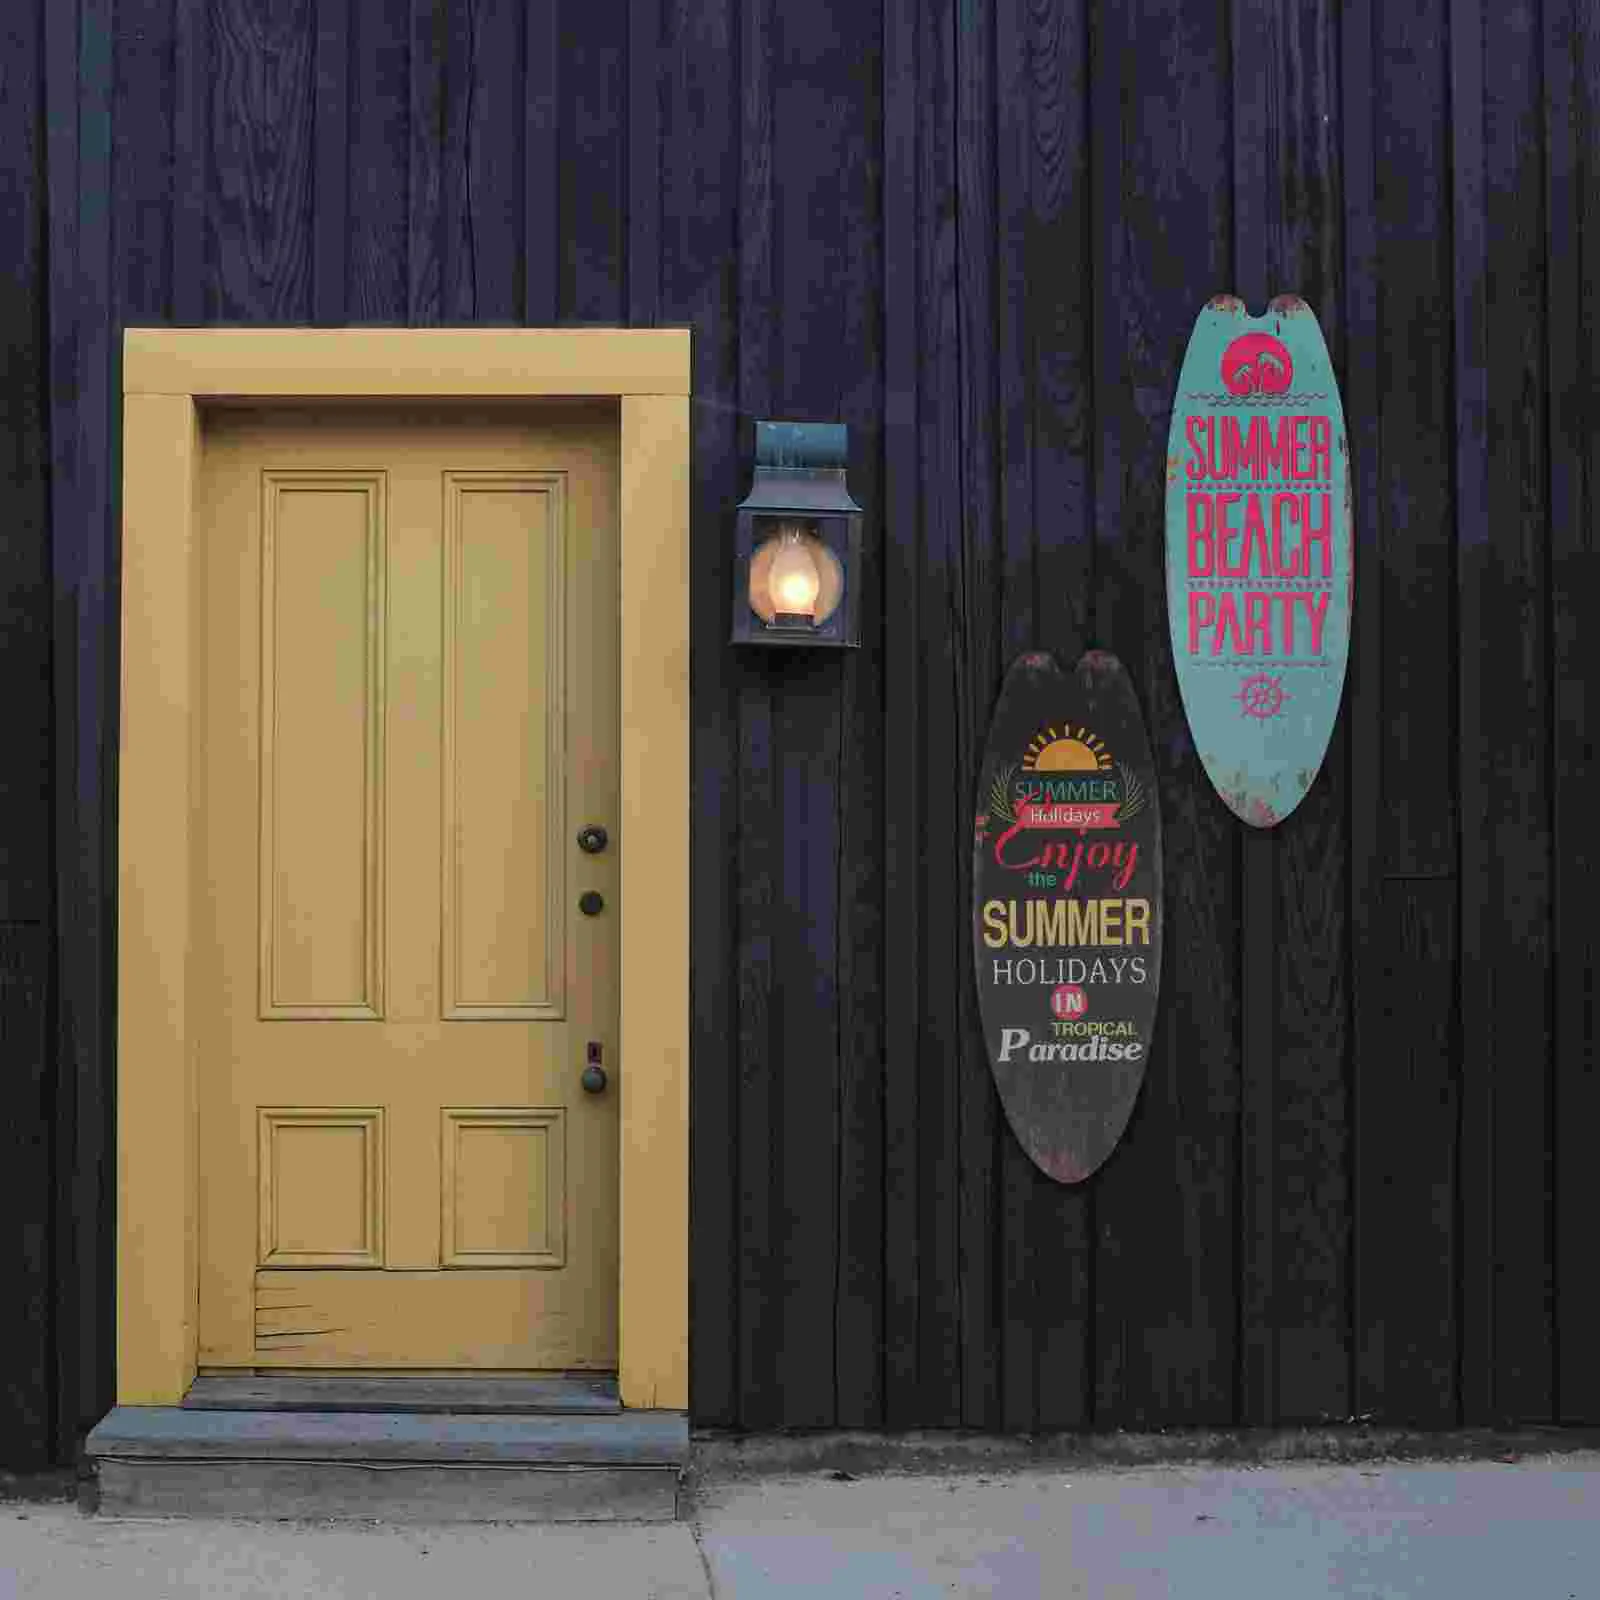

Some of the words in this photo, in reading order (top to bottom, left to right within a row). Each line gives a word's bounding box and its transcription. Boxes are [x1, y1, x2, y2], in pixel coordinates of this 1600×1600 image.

[1185, 415, 1332, 481] SUMMER
[1186, 492, 1332, 578] BEACH
[1187, 591, 1329, 656] PARTY
[1015, 781, 1117, 801] SUMMER
[1031, 807, 1103, 826] Holidays
[994, 790, 1138, 892] Enjoy
[1027, 872, 1057, 889] the
[983, 899, 1151, 948] SUMMER
[992, 957, 1147, 985] HOLIDAYS
[1054, 992, 1083, 1013] IN
[1053, 1021, 1138, 1037] TROPICAL
[998, 1028, 1143, 1063] Paradise
